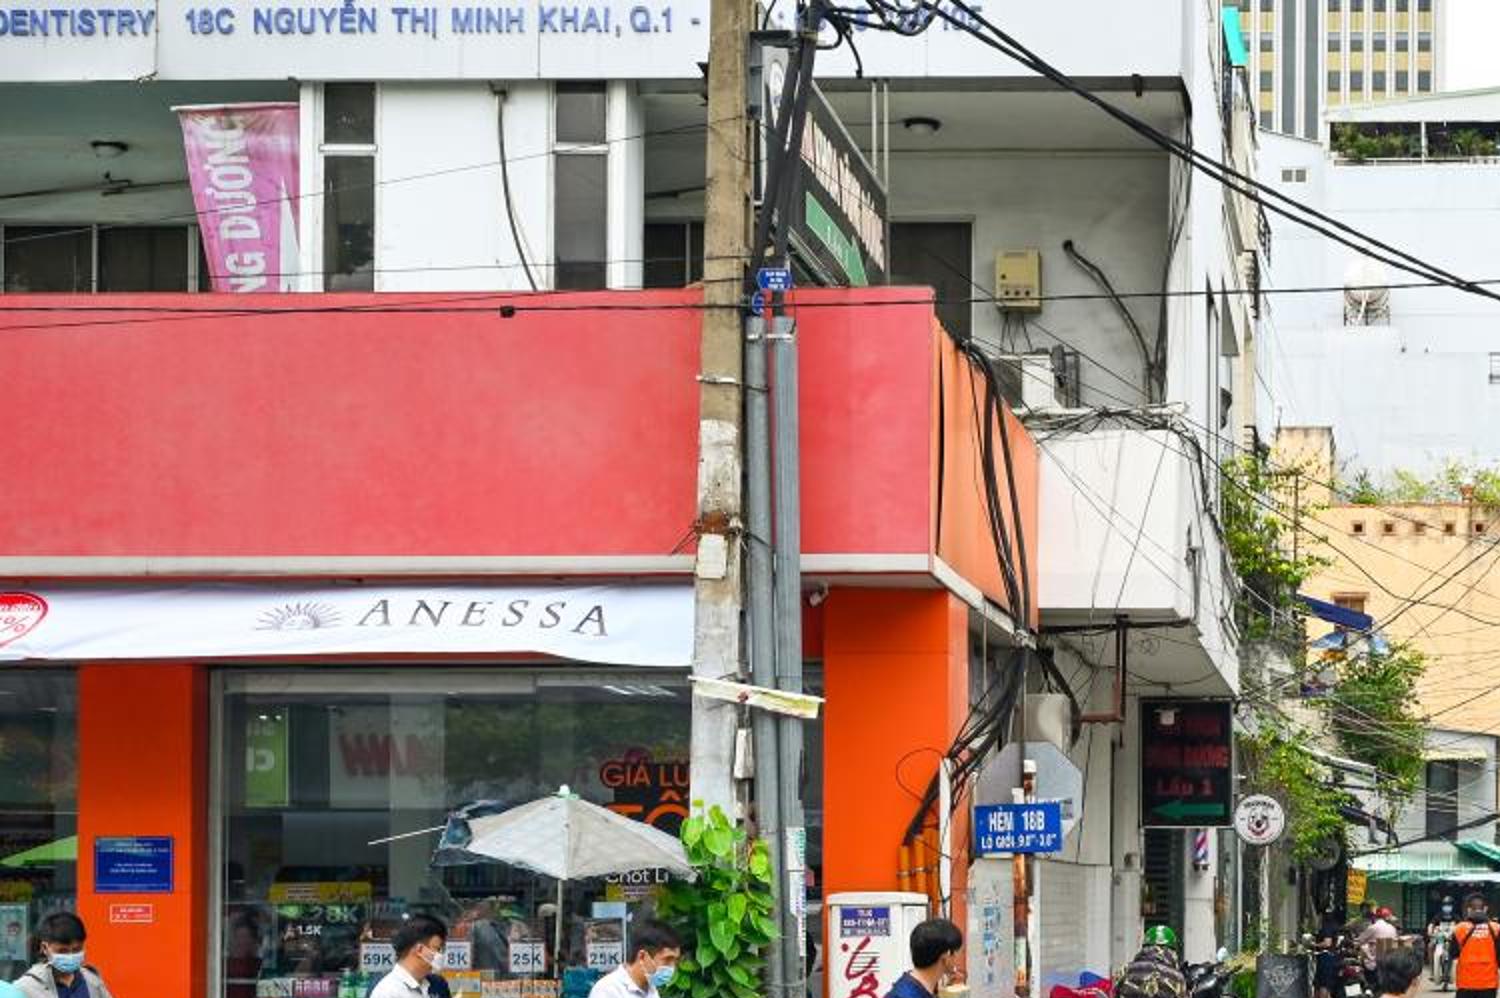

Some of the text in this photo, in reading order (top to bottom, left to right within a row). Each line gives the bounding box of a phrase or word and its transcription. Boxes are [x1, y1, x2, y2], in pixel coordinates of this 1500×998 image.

[186, 8, 235, 35] 18C
[392, 7, 437, 39] THỊ
[451, 8, 525, 34] MINH
[630, 7, 673, 33] Q.1
[356, 599, 608, 636] ANESSA
[1022, 810, 1045, 831] 18B
[512, 952, 542, 965] 25K
